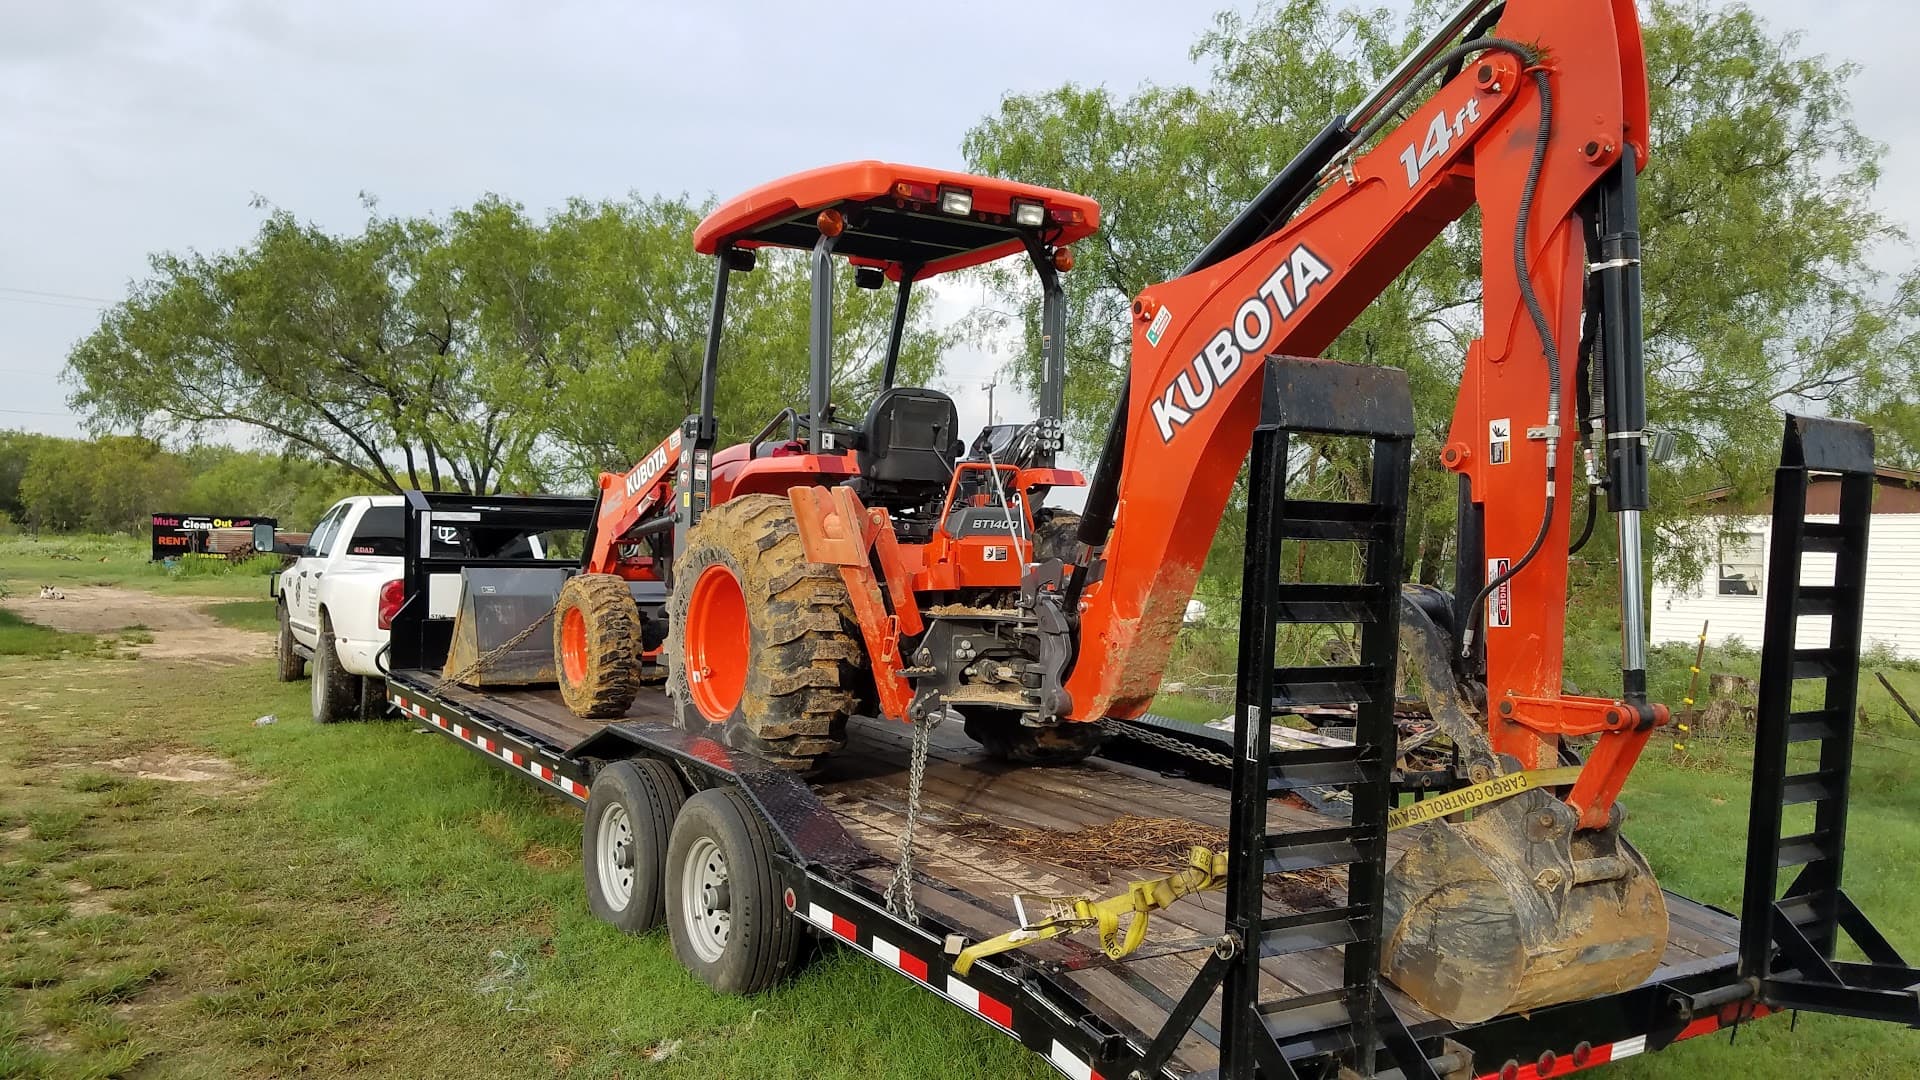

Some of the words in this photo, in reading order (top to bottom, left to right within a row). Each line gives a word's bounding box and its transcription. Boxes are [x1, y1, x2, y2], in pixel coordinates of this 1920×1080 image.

[1150, 243, 1333, 444] KUBOTA
[626, 446, 668, 497] KUBOTA
[153, 517, 179, 526] Mutz
[183, 520, 213, 529] Clean
[213, 519, 232, 527] Out
[973, 519, 1019, 529] BT1400
[158, 536, 188, 545] RENT
[1486, 775, 1528, 796] CARGO
[1430, 788, 1484, 814] CONTROL
